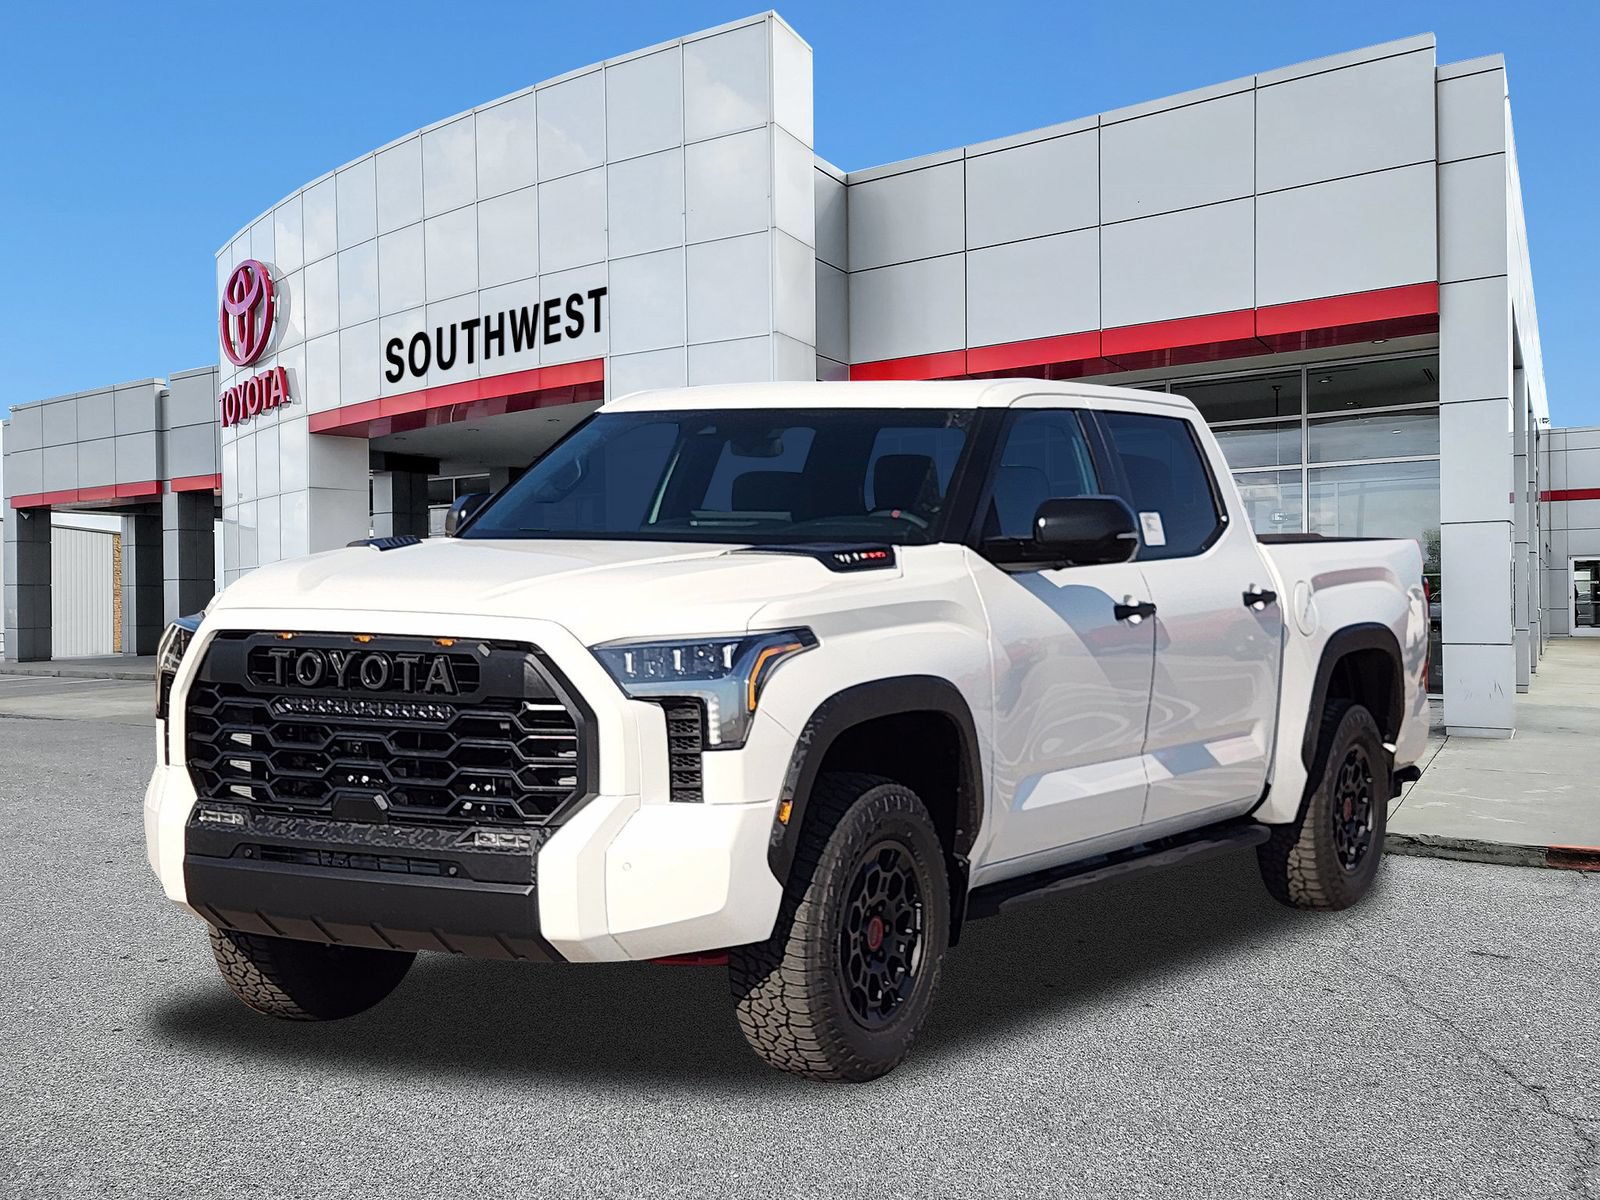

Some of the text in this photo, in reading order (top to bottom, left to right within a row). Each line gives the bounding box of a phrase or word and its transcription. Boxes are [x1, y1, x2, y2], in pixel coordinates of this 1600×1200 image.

[385, 286, 608, 384] SOUTHWEST
[218, 366, 291, 427] TOYOTA
[269, 648, 460, 696] TOYOTA
